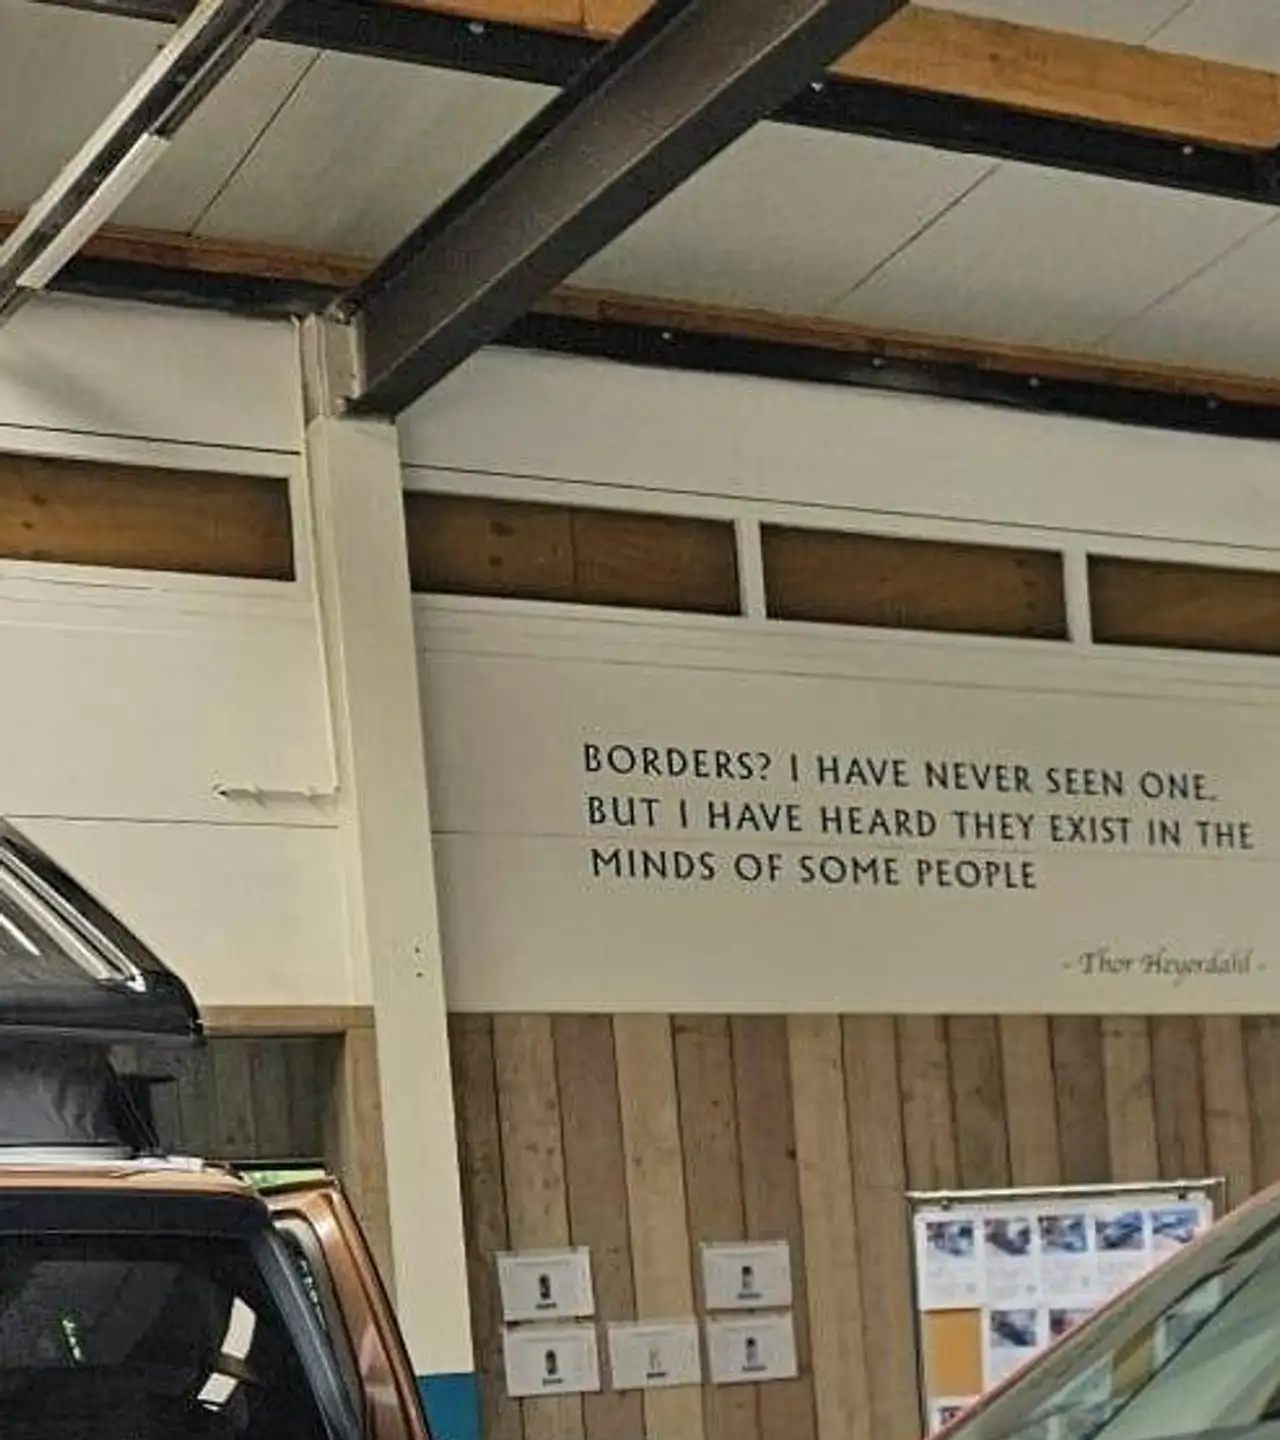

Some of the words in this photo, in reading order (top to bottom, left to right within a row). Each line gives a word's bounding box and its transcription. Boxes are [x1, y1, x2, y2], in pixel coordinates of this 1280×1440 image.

[583, 742, 772, 782] BORDERS?
[790, 752, 799, 783] I
[816, 754, 910, 788] HAVE
[924, 760, 1033, 793] NEVER
[1045, 767, 1124, 797] SEEN
[1139, 770, 1218, 801] ONE.
[587, 795, 661, 828] BUT
[679, 798, 688, 829] I
[707, 800, 803, 832] HAVE
[819, 805, 937, 838] HEARD
[950, 809, 1035, 841] THEY
[1049, 814, 1131, 845] EXIST
[1148, 819, 1181, 847] IN
[1195, 820, 1254, 850] THE
[590, 848, 716, 881] MINDS
[733, 853, 783, 883] OF
[798, 855, 901, 887] SOME
[916, 858, 1037, 890] PEOPLE
